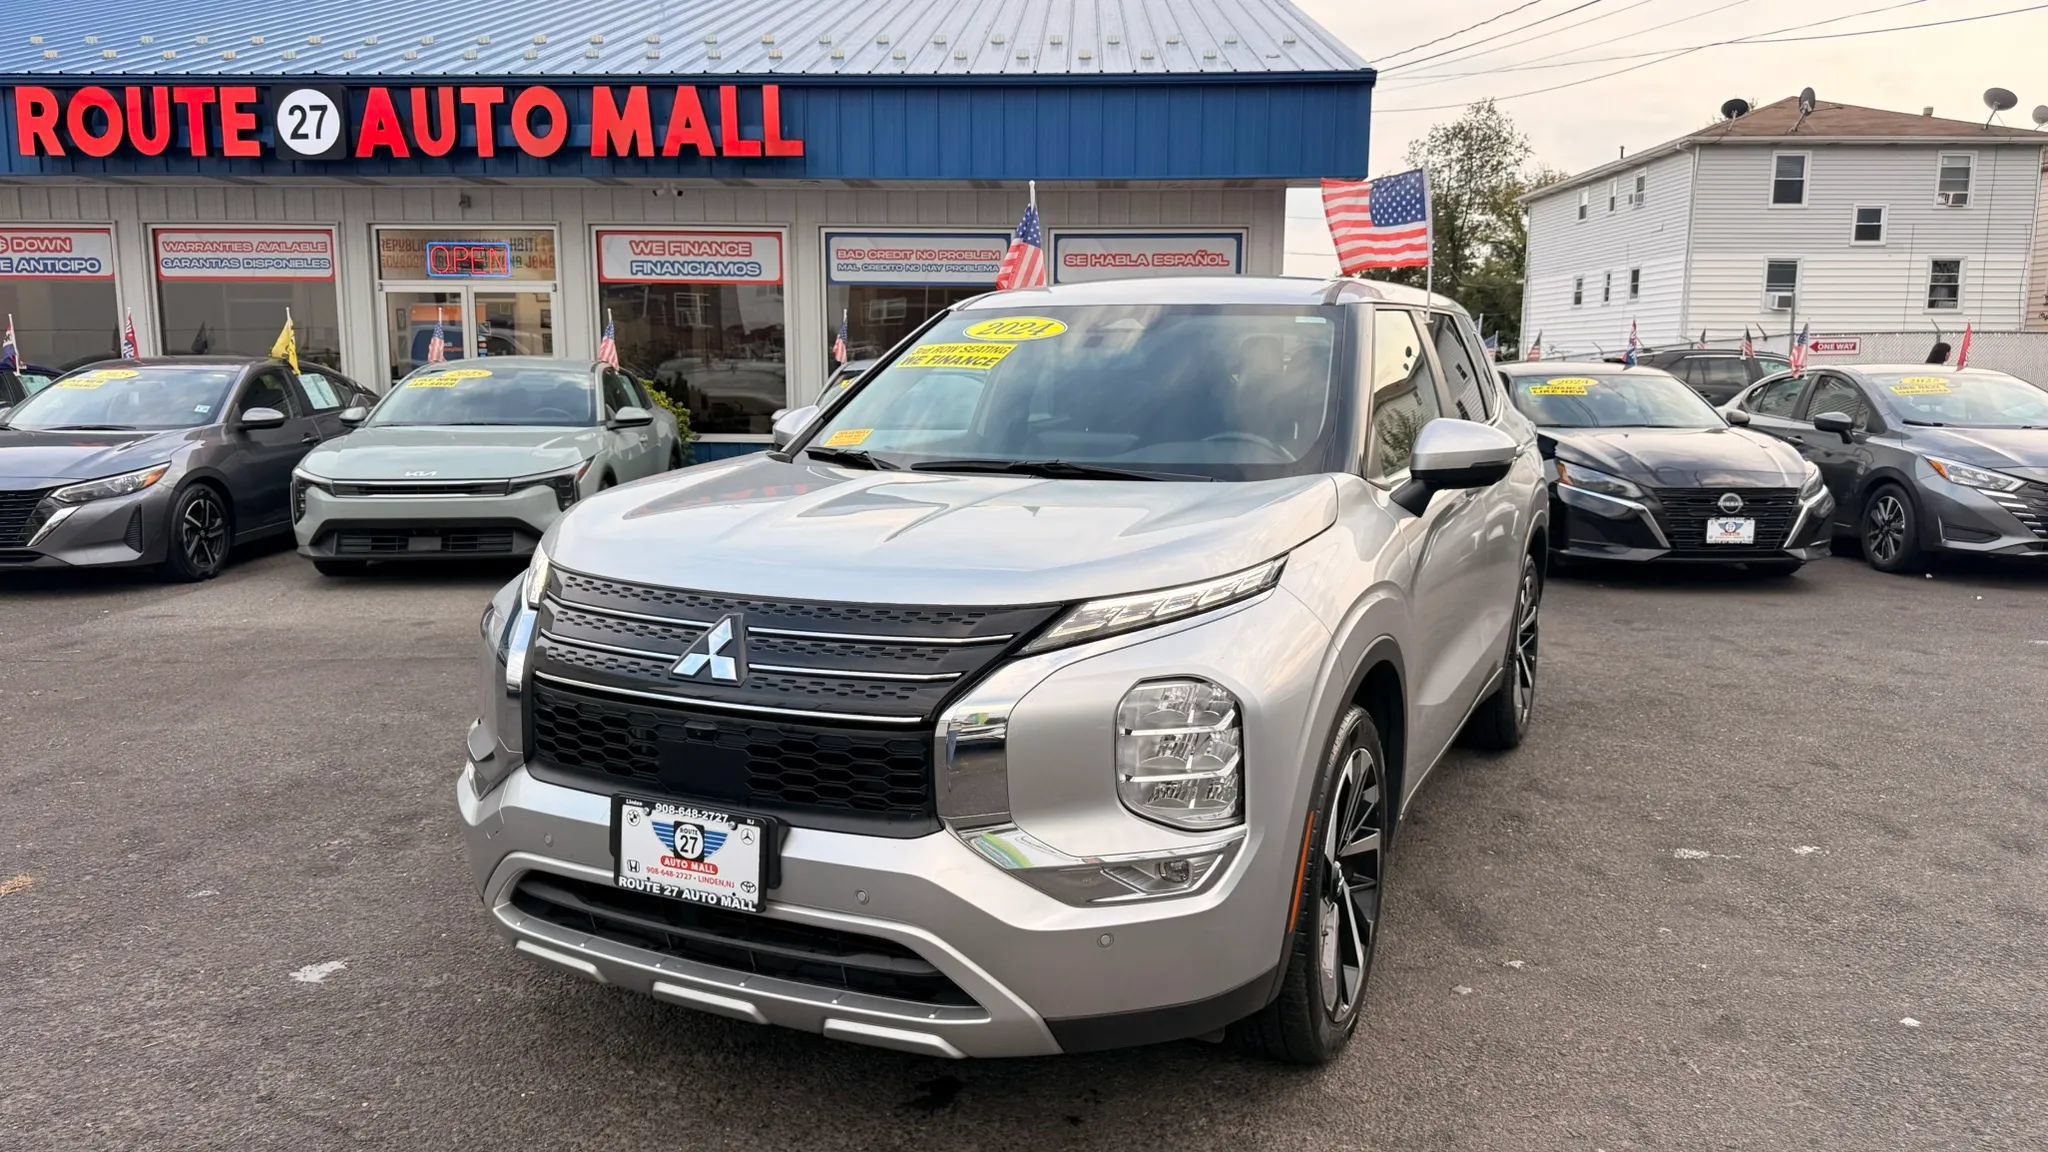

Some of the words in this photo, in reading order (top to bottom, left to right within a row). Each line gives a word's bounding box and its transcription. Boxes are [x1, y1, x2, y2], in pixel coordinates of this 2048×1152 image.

[14, 85, 261, 157] ROUTE
[288, 104, 329, 140] 27
[355, 85, 569, 158] AUTO
[592, 85, 804, 158] MALL
[10, 237, 73, 253] DOWN
[162, 241, 253, 253] WARRANTIES
[255, 241, 328, 253] AVAILABLE
[630, 240, 665, 255] WE
[668, 240, 752, 257] FINANCE
[430, 245, 508, 274] OPEN
[836, 249, 865, 260] BAD
[867, 249, 913, 260] CREDIT
[915, 250, 936, 261] NO
[937, 250, 1001, 261] PROBLEM
[1064, 253, 1088, 267] SE
[1090, 254, 1148, 267] HABLA
[1151, 250, 1230, 267] ESPAÑOL
[15, 257, 102, 273] ANTICIPO
[161, 257, 240, 269] GARANTIAS
[242, 257, 331, 270] DISPONIBLES
[631, 260, 762, 277] FINANCIAMOS
[837, 263, 861, 272] MAL
[862, 263, 904, 272] CREDITO
[905, 264, 920, 272] NO
[921, 264, 944, 272] HAY
[944, 263, 1000, 273] PROBLEMA
[976, 321, 1056, 336] 2024
[931, 345, 959, 355] ROW
[959, 345, 1012, 355] SEATING
[900, 356, 926, 366] WE
[925, 355, 1000, 367] FINANCE
[626, 798, 643, 807] Linden
[655, 802, 729, 824] 908-648-2727
[679, 827, 699, 836] ROUTE
[679, 835, 699, 855] 27
[646, 866, 692, 881] 908-648-2727
[664, 857, 687, 869] AUTO
[690, 862, 716, 874] MALL
[618, 875, 661, 894] ROUTE
[663, 884, 679, 897] 27
[681, 888, 718, 904] AUTO
[720, 894, 757, 912] MALL
